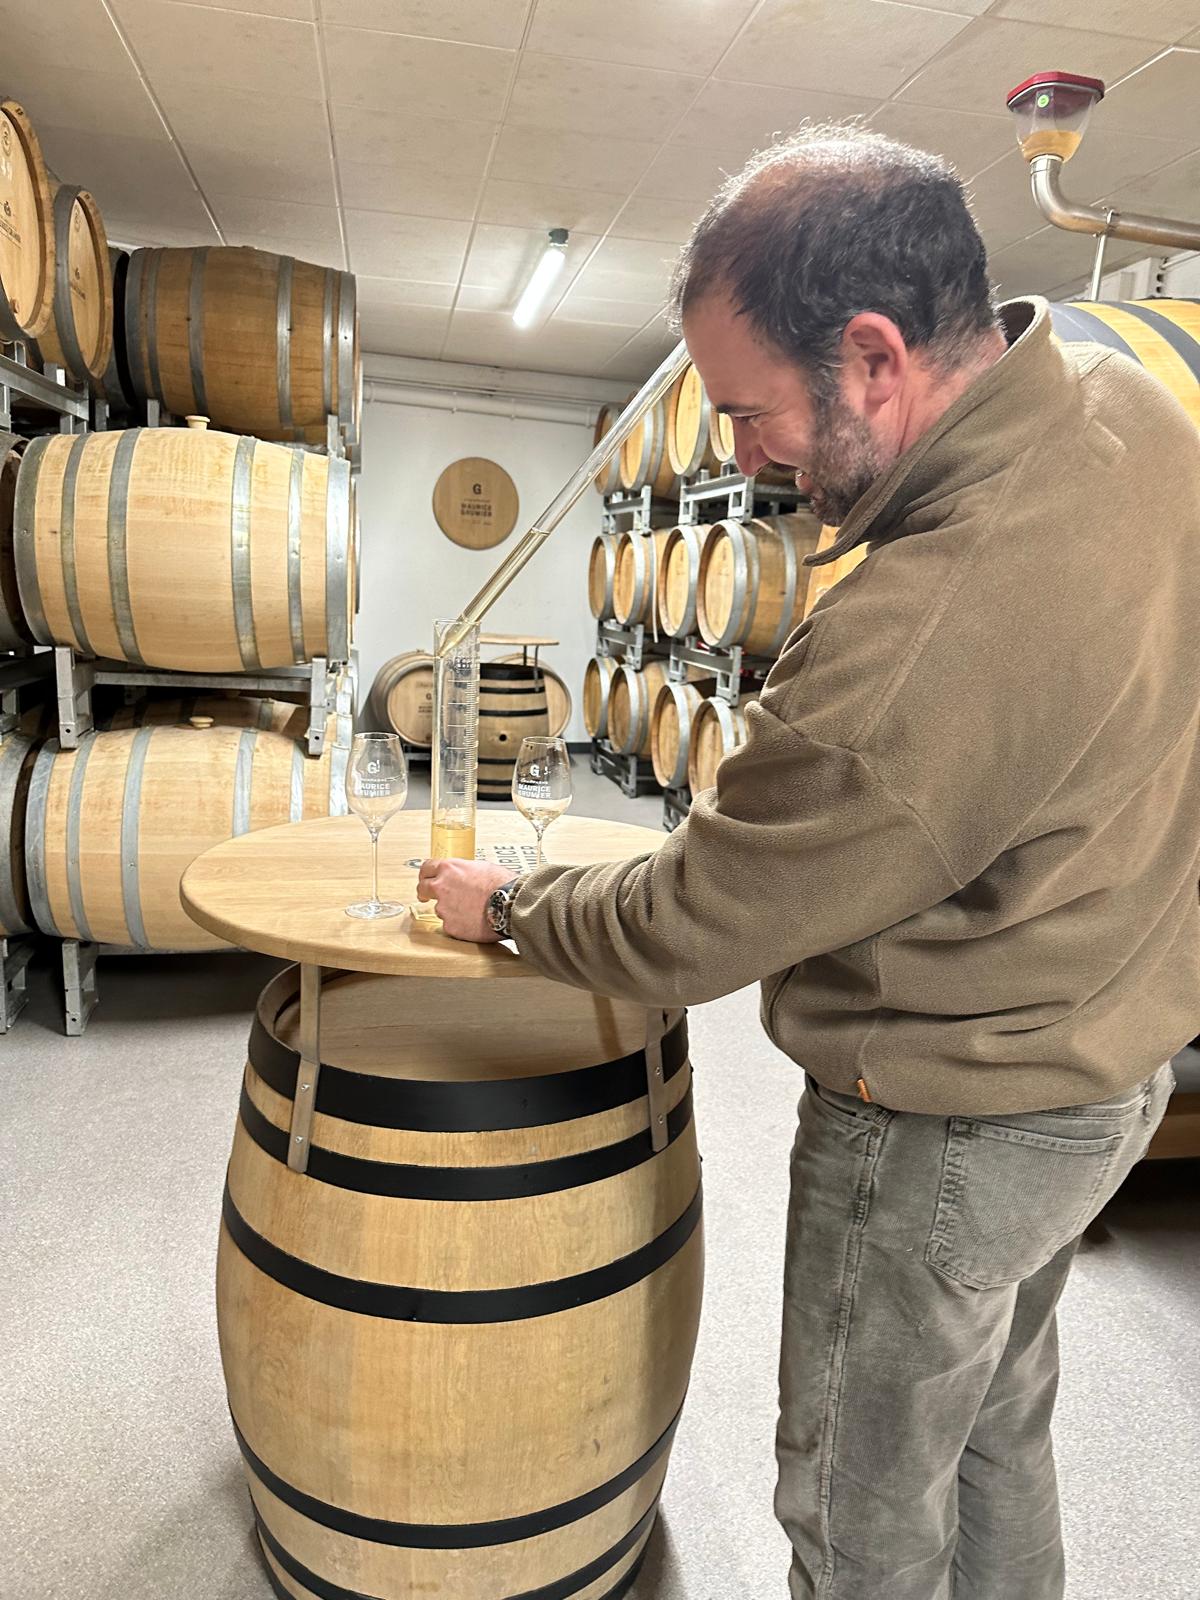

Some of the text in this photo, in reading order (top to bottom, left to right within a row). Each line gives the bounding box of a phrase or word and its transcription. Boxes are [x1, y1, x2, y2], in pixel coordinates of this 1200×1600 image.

[472, 483, 482, 495] G
[529, 764, 541, 777] G
[518, 783, 551, 793] MAURICE
